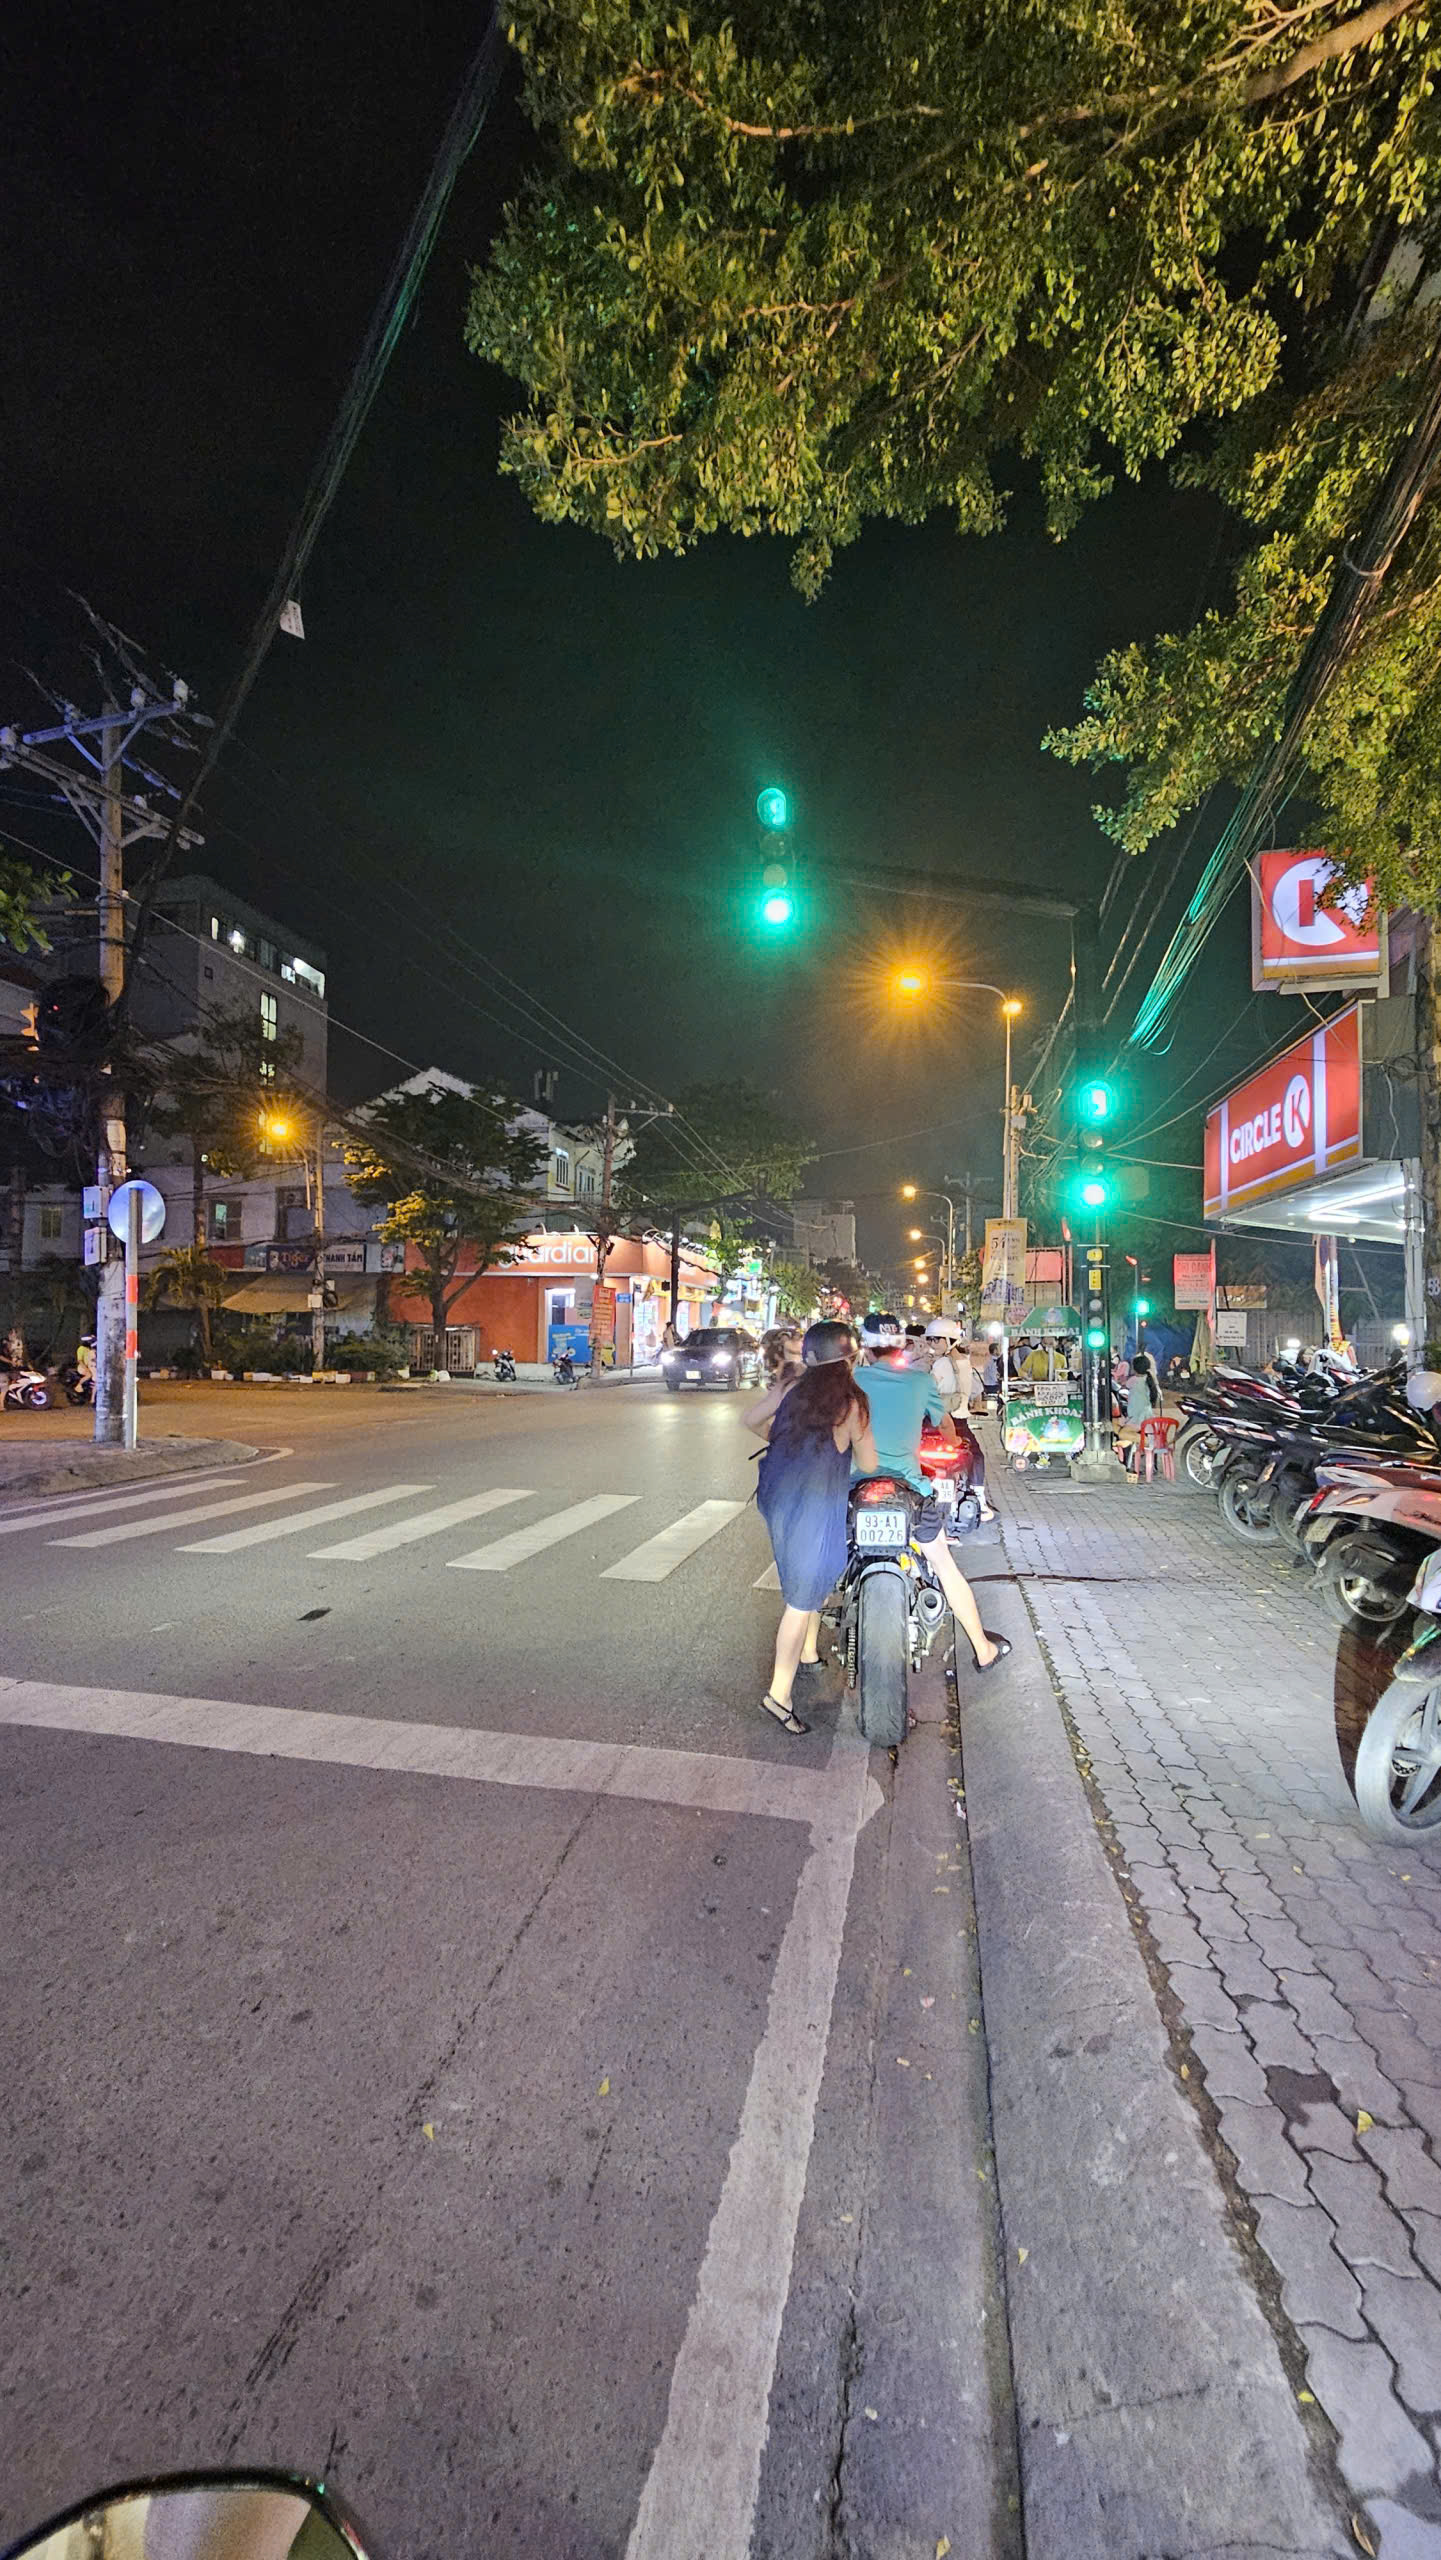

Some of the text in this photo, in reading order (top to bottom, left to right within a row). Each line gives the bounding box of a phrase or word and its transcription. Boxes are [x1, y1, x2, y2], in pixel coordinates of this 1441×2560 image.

[1229, 1074, 1310, 1164] CIRCLE K
[865, 1515, 898, 1528] 93-A1
[860, 1530, 903, 1542] 002.26
